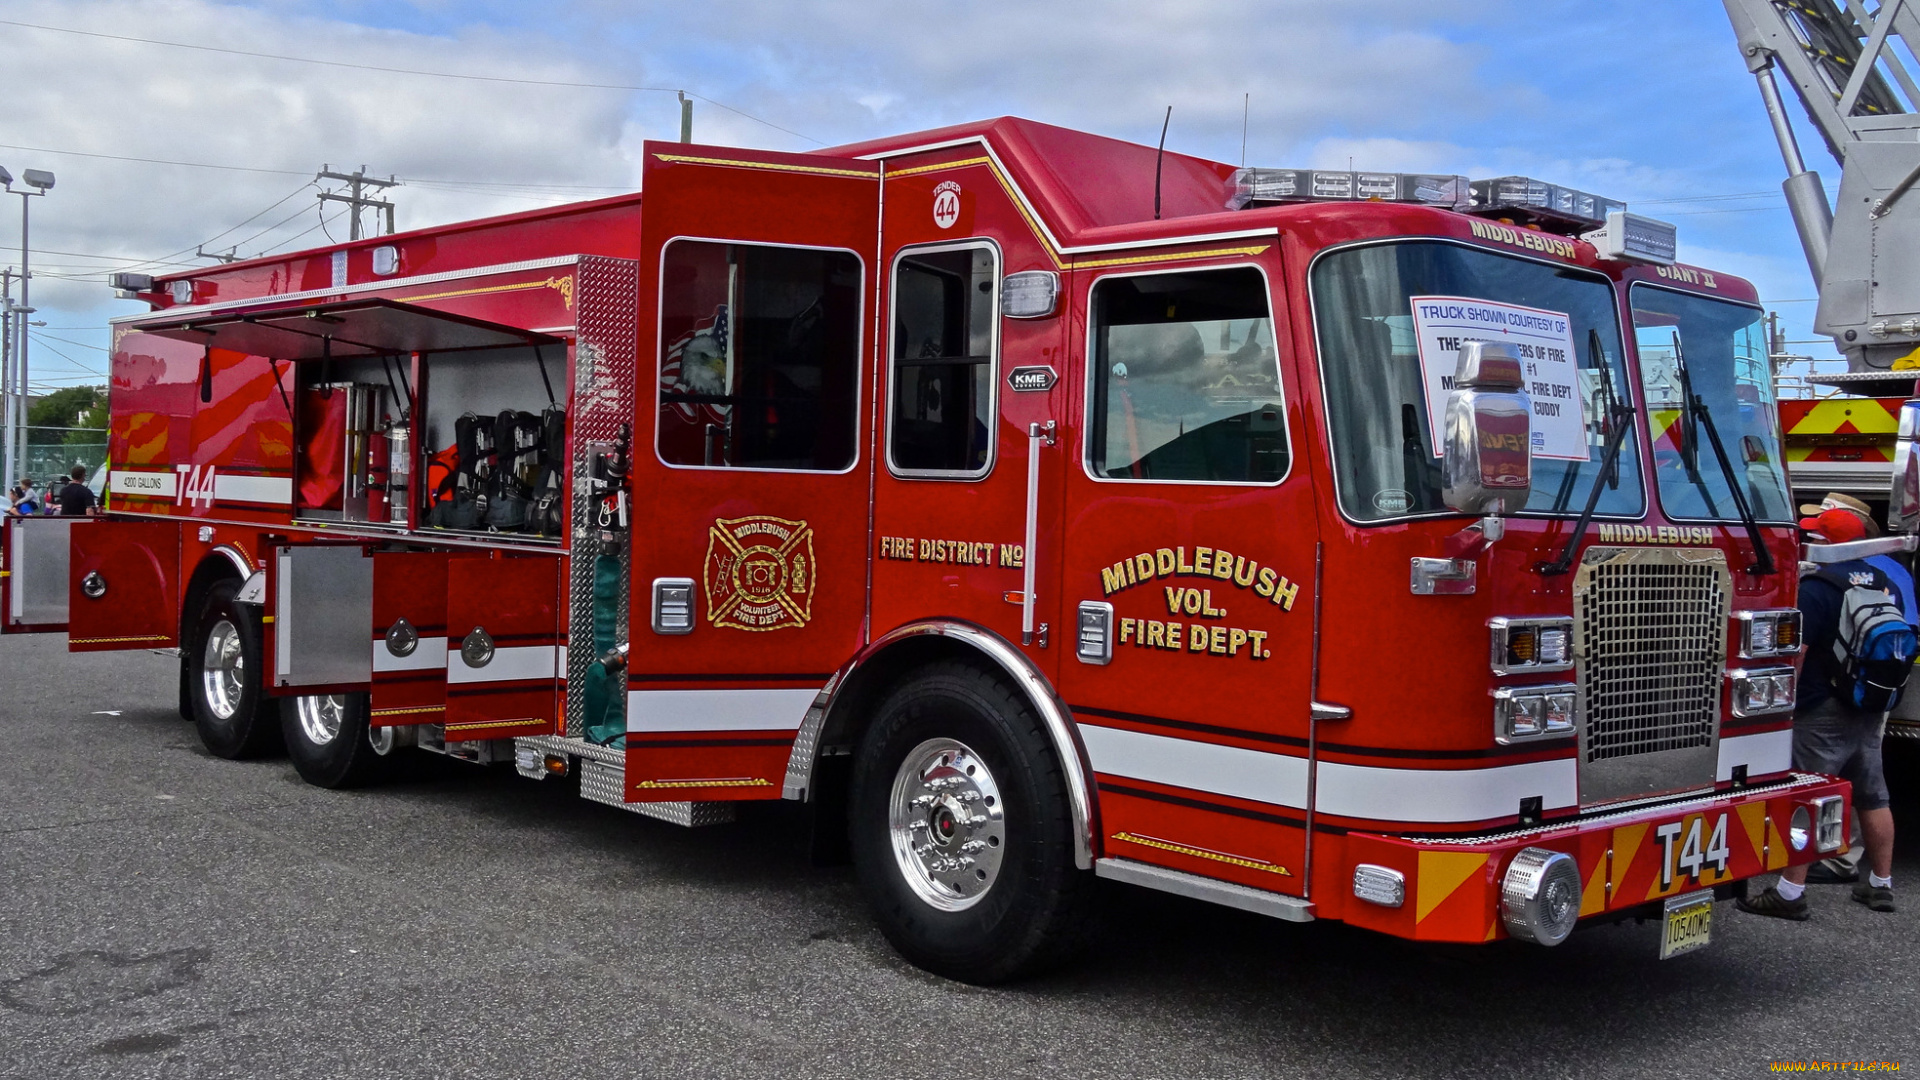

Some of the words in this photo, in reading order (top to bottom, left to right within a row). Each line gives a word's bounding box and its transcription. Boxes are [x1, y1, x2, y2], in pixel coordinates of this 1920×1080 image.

[933, 180, 961, 197] TENDER
[937, 197, 955, 220] 44
[1469, 220, 1576, 259] MIDDLEBUSH
[1656, 265, 1700, 285] GIANT
[1702, 271, 1717, 288] II
[1420, 305, 1466, 320] TRUCK
[1468, 307, 1507, 324] SHOWN
[1508, 313, 1553, 331] COURTESY
[1555, 321, 1566, 333] OF
[1437, 337, 1461, 351] THE
[1535, 344, 1546, 360] OF
[1548, 347, 1566, 363] FIRE
[1015, 374, 1046, 384] KME
[1527, 362, 1538, 376] #1
[1532, 381, 1551, 397] FIRE
[1552, 383, 1572, 399] DEPT
[1534, 401, 1560, 417] CUDDY
[123, 477, 137, 488] 4200
[138, 477, 162, 489] GALLONS
[176, 464, 216, 508] T44
[734, 523, 789, 540] MIDDLEBUSH
[1598, 524, 1714, 545] MIDDLEBUSH
[881, 536, 914, 559] FIRE
[920, 538, 994, 566] DISTRICT
[1101, 546, 1299, 613] MIDDLEBUSH
[740, 602, 781, 615] VOLUNTEER
[1165, 586, 1227, 617] VOL.
[732, 609, 756, 625] FIRE
[758, 610, 787, 625] DEPT.
[1120, 617, 1183, 649] FIRE
[1190, 624, 1271, 659] DEPT.
[1656, 812, 1730, 887] T44
[1668, 910, 1710, 944] 10540MG
